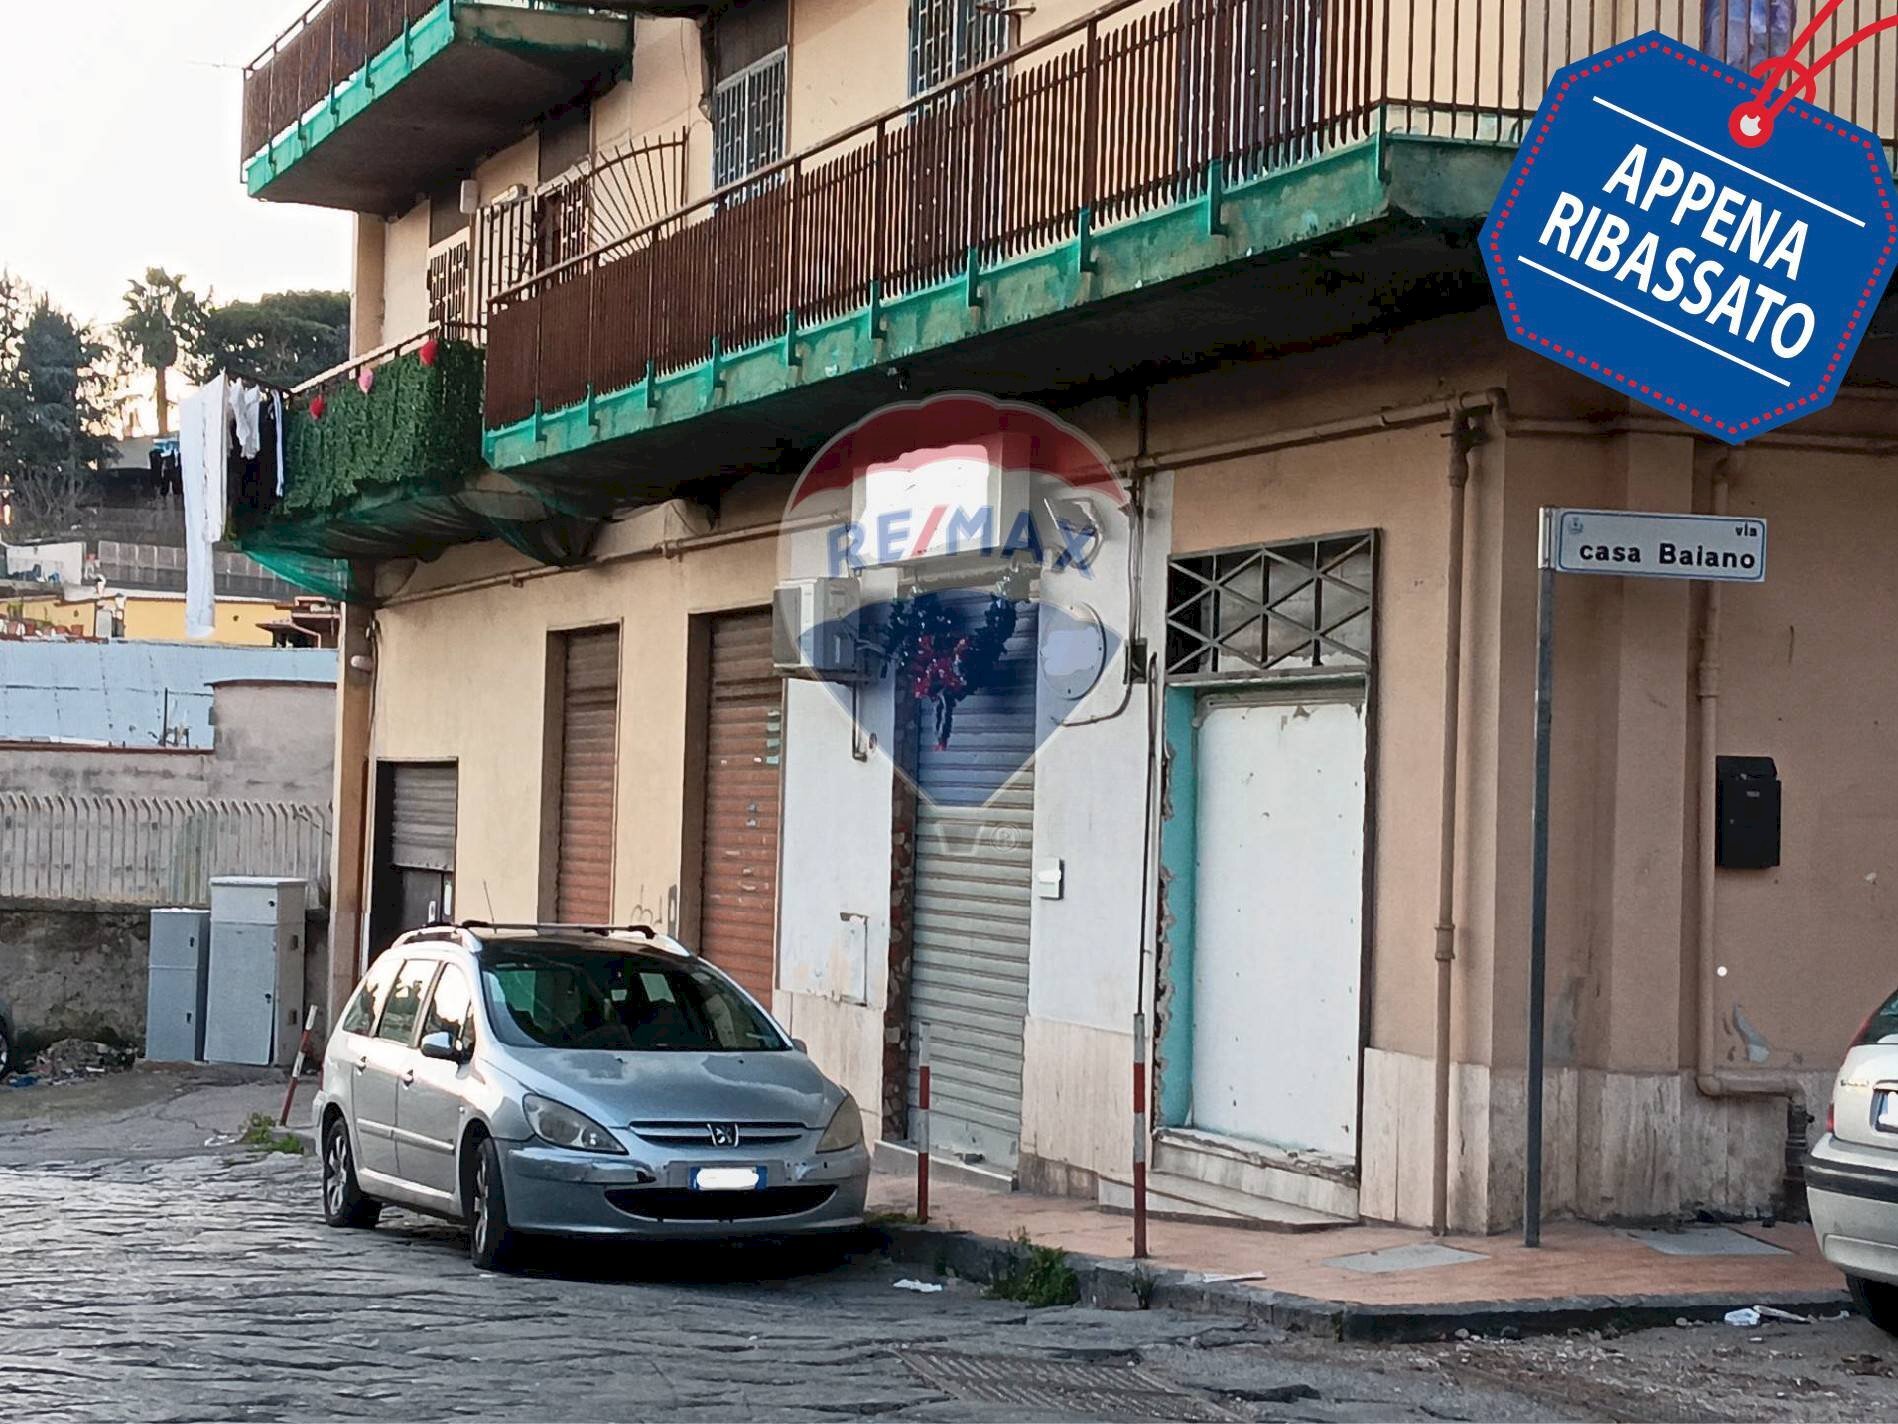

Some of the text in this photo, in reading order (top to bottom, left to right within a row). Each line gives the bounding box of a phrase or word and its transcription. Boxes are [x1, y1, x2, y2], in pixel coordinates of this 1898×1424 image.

[1735, 520, 1758, 537] via
[1579, 543, 1755, 569] casa Baiano
